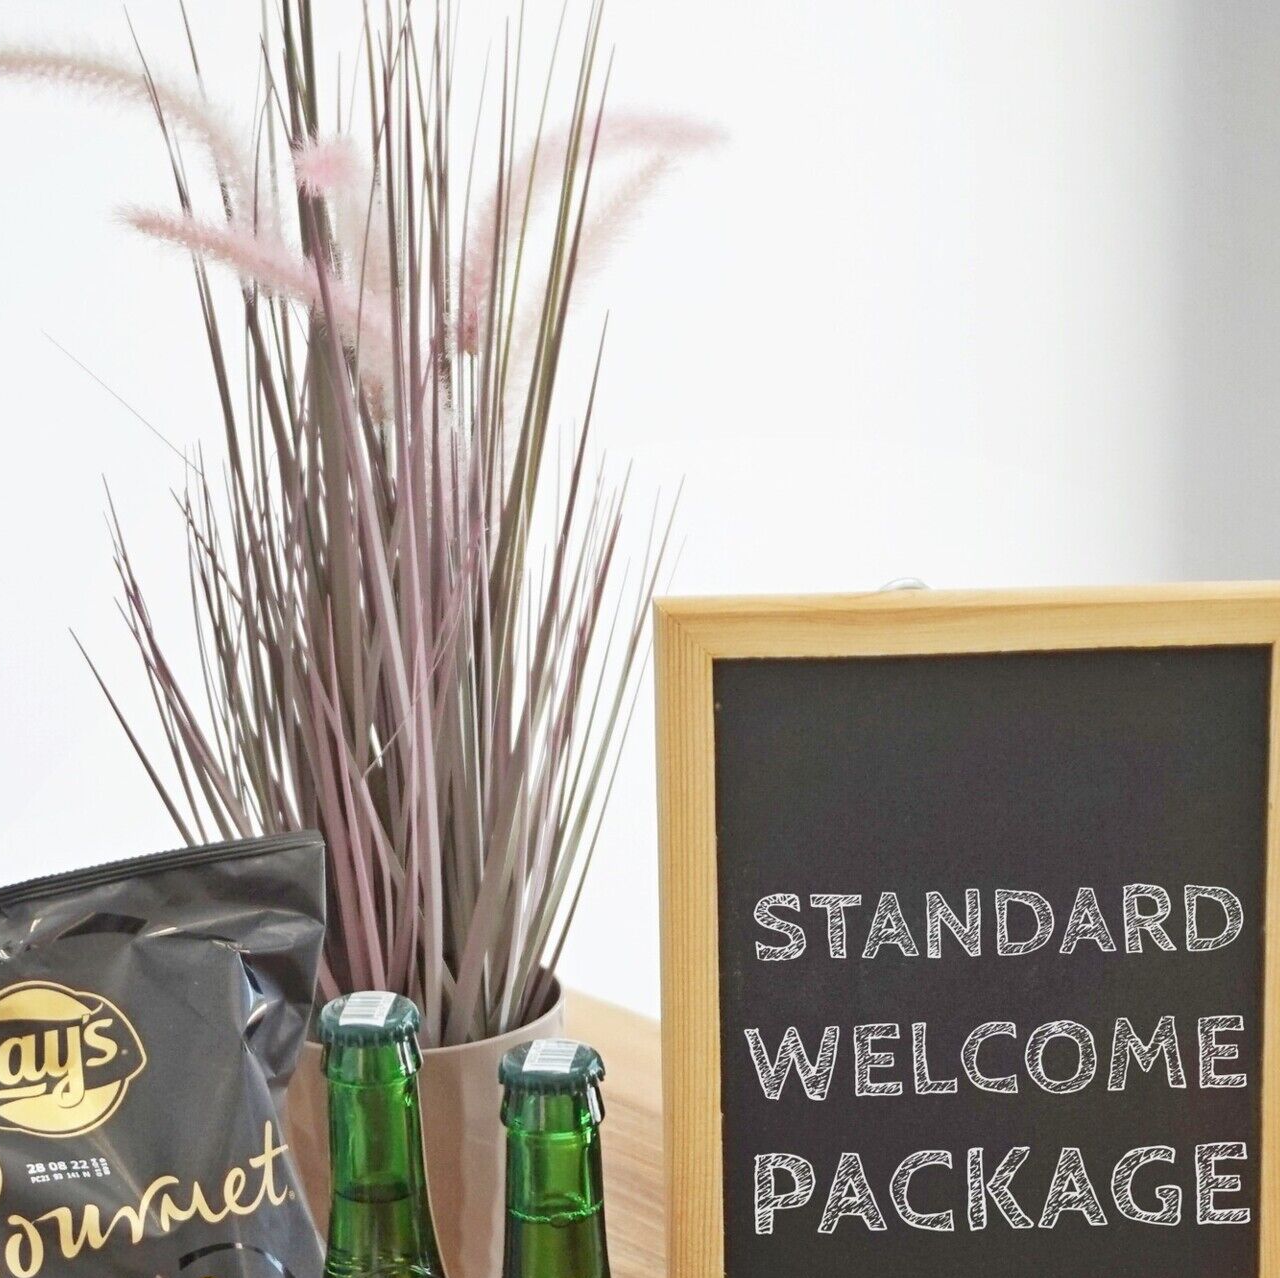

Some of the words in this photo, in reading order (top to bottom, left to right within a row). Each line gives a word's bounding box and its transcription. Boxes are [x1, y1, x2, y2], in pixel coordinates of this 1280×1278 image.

[754, 884, 1244, 961] STANDARD
[744, 1015, 1247, 1100] WELCOME
[70, 1159, 89, 1170] 22
[754, 1141, 1251, 1235] PACKAGE
